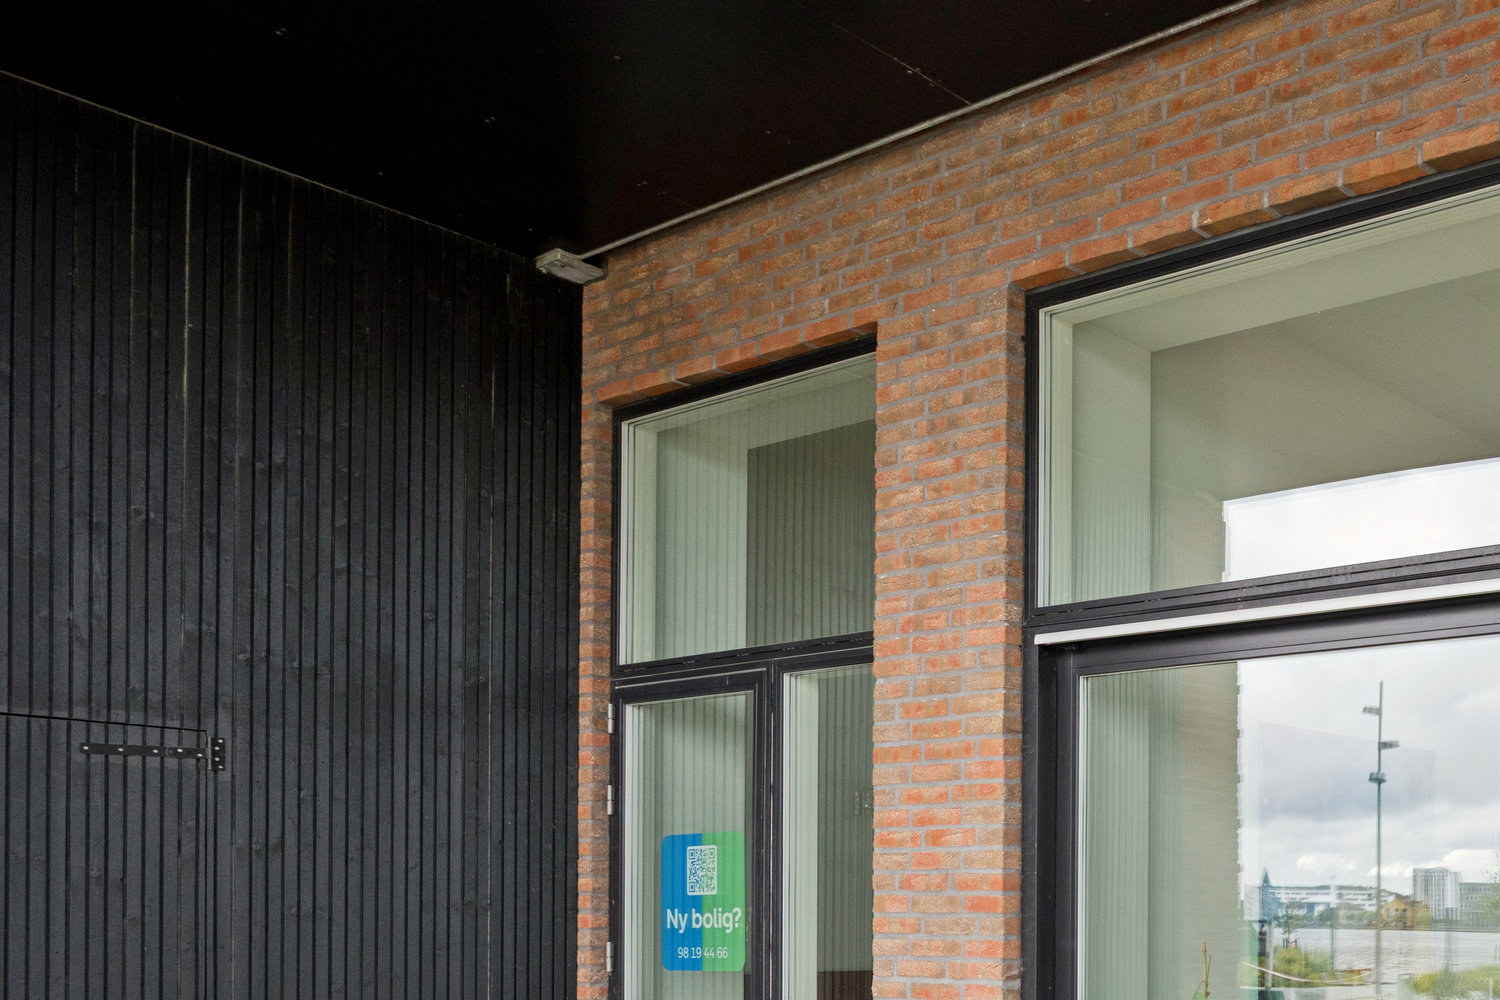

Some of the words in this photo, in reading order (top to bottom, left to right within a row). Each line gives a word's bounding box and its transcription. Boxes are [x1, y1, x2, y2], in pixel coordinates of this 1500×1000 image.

[667, 908, 688, 934] Ny
[692, 907, 741, 934] bolig?
[677, 946, 689, 958] 98
[691, 946, 702, 958] 19
[704, 947, 715, 958] 44
[717, 947, 728, 958] 66
